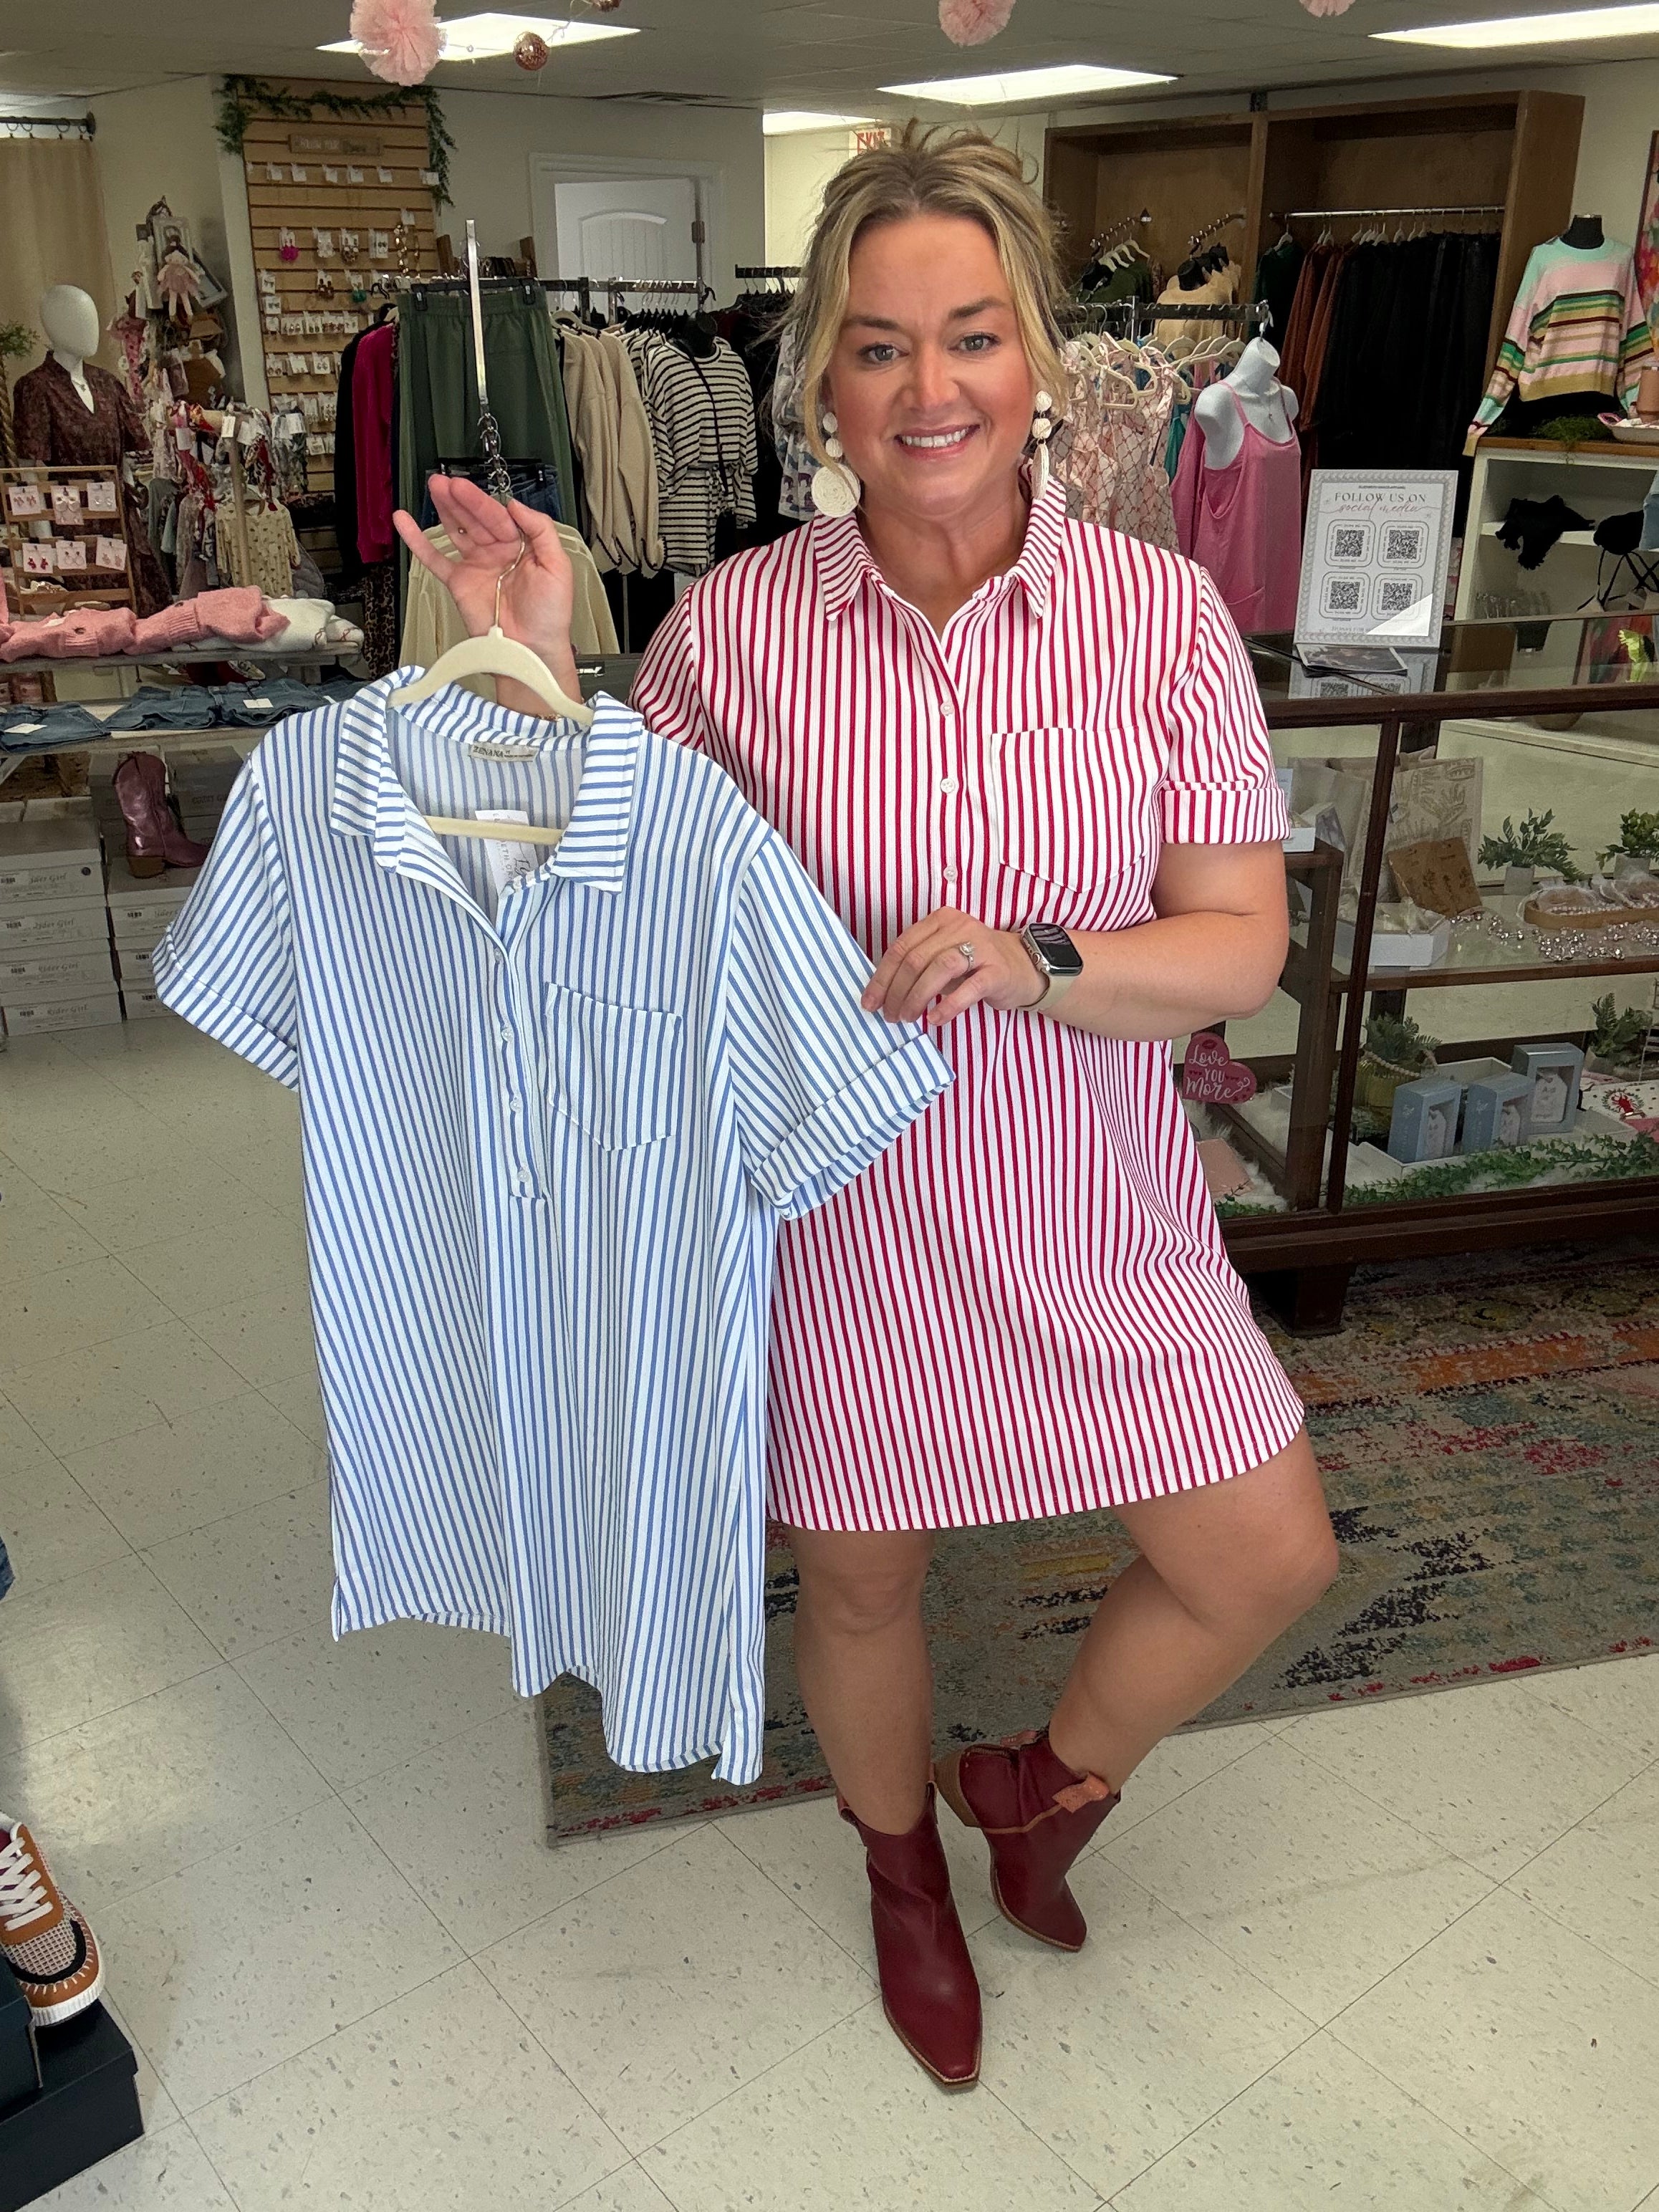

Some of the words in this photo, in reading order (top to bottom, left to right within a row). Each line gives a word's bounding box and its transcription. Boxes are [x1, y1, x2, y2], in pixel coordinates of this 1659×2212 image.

[1335, 492, 1384, 502] FOLLOW
[1390, 493, 1404, 502] US
[1408, 494, 1426, 503] ON
[473, 746, 504, 758] ZENANA
[1188, 1044, 1228, 1067] Love
[1204, 1068, 1225, 1082] YOU
[1186, 1077, 1246, 1100] More
